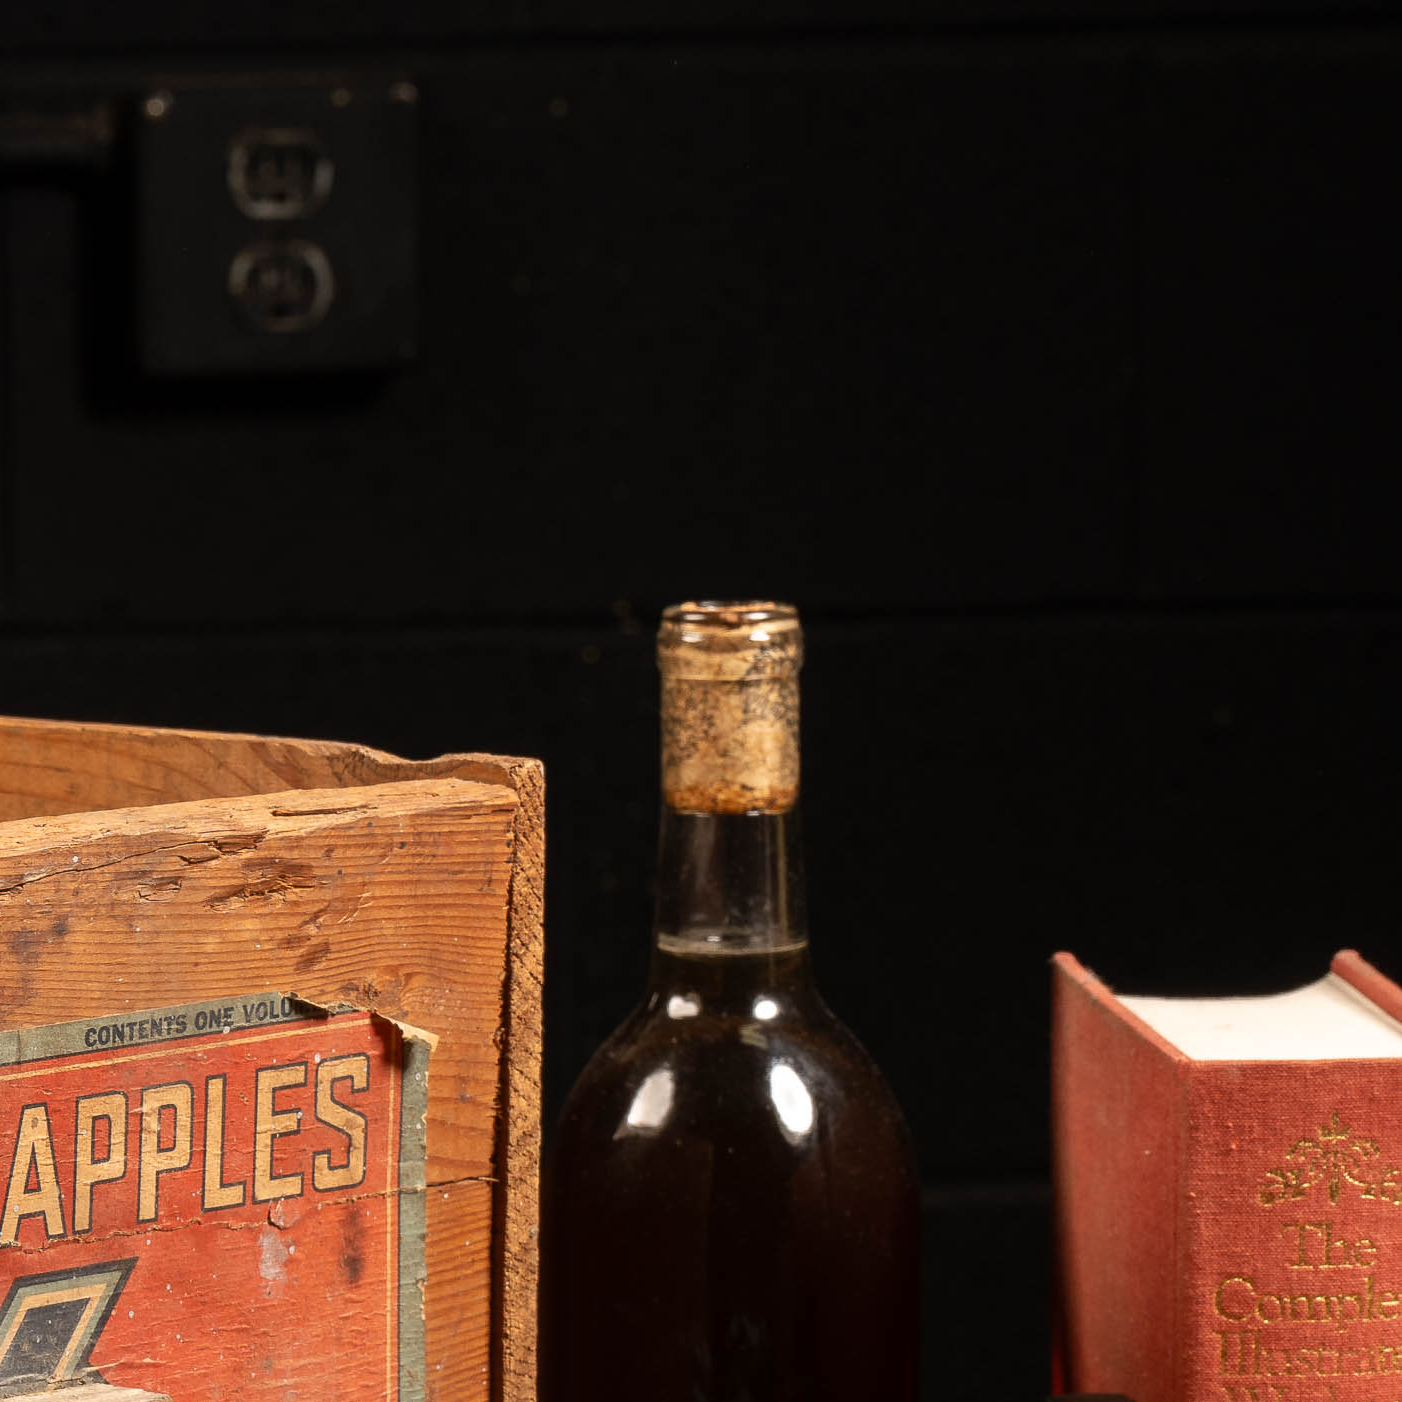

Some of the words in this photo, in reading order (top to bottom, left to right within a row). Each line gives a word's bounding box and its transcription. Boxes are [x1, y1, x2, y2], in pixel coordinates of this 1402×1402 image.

[84, 1012, 188, 1048] CONTENTS
[194, 1005, 235, 1030] ONE
[242, 997, 294, 1023] VOLU
[1279, 1221, 1378, 1270] The
